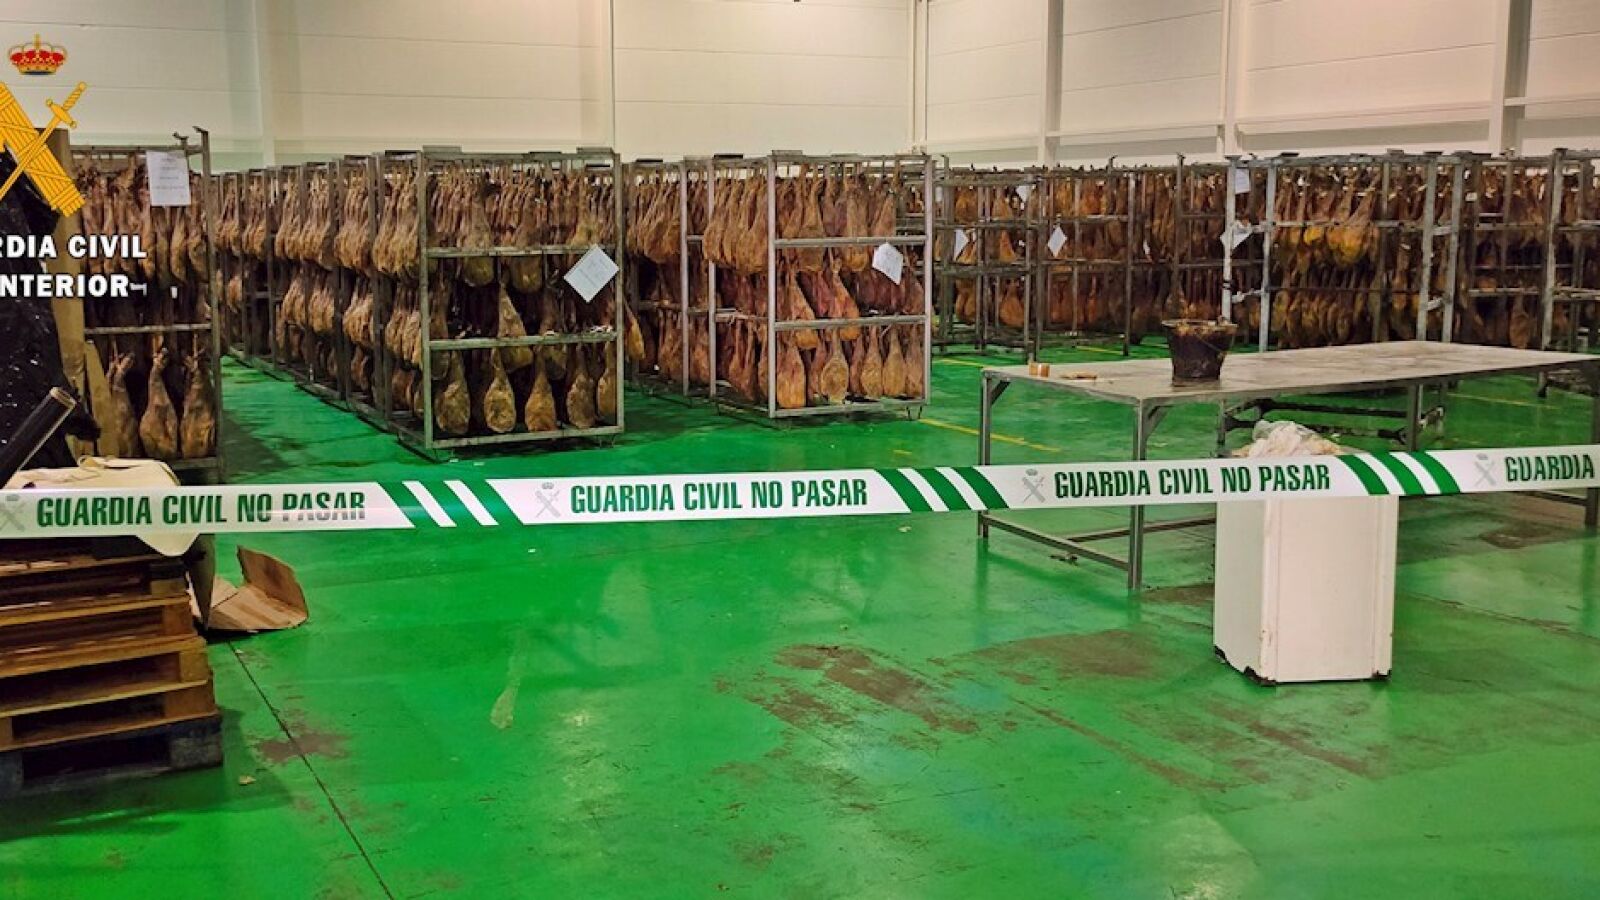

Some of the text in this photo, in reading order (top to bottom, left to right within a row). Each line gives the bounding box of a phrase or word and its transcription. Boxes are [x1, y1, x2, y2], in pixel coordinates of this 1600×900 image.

[1054, 464, 1330, 498] GUARDIA CIVIL NO PASAR
[1504, 453, 1595, 483] GUARDIA
[36, 491, 366, 528] GUARDIA CIVIL NO PASAR
[570, 478, 868, 514] GUARDIA CIVIL NO PASAR
